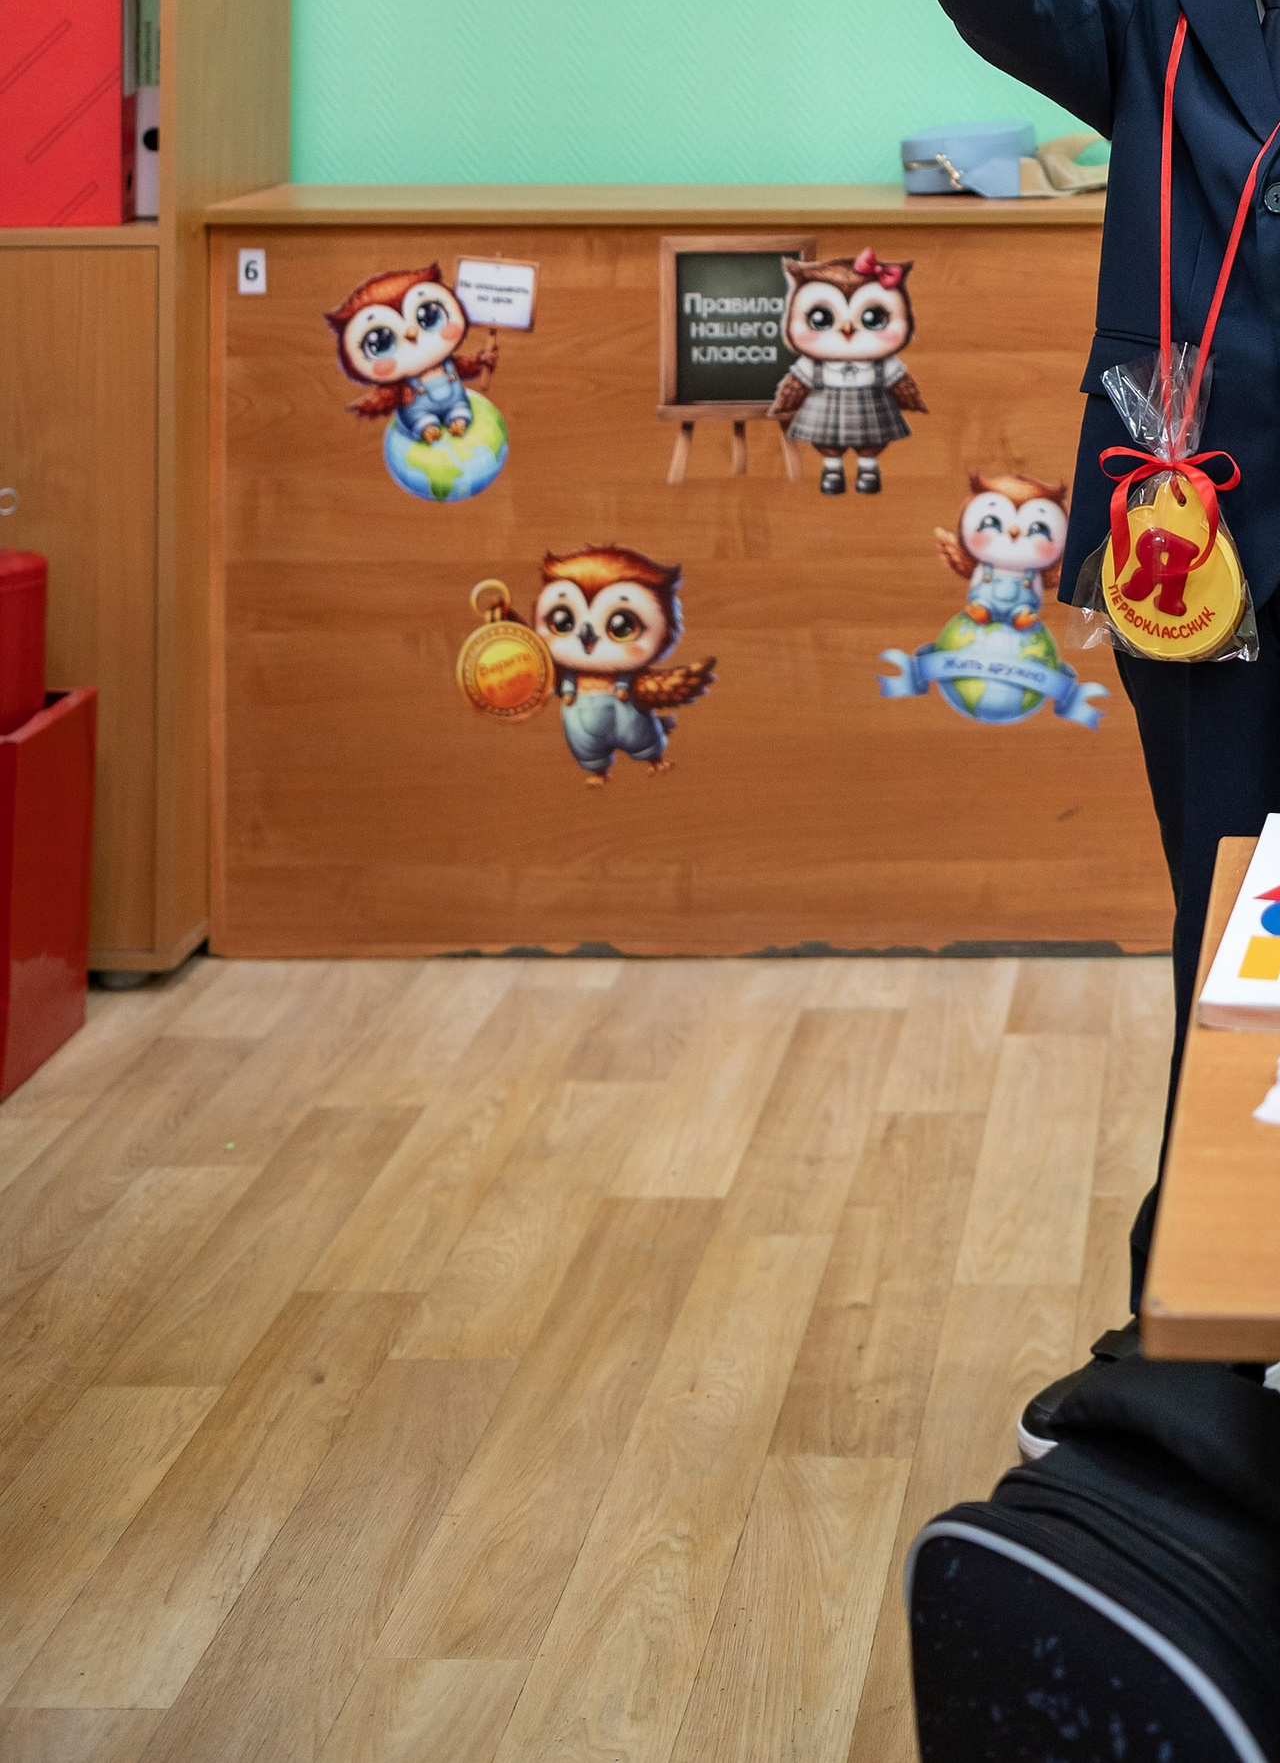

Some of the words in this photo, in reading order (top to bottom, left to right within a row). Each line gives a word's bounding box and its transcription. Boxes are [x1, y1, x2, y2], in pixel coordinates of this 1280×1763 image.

[244, 259, 258, 282] 6
[684, 292, 784, 319] Правила
[689, 321, 778, 339] нашего
[691, 345, 778, 364] класса
[1108, 584, 1216, 639] ПЕРВОКЛАССНИК
